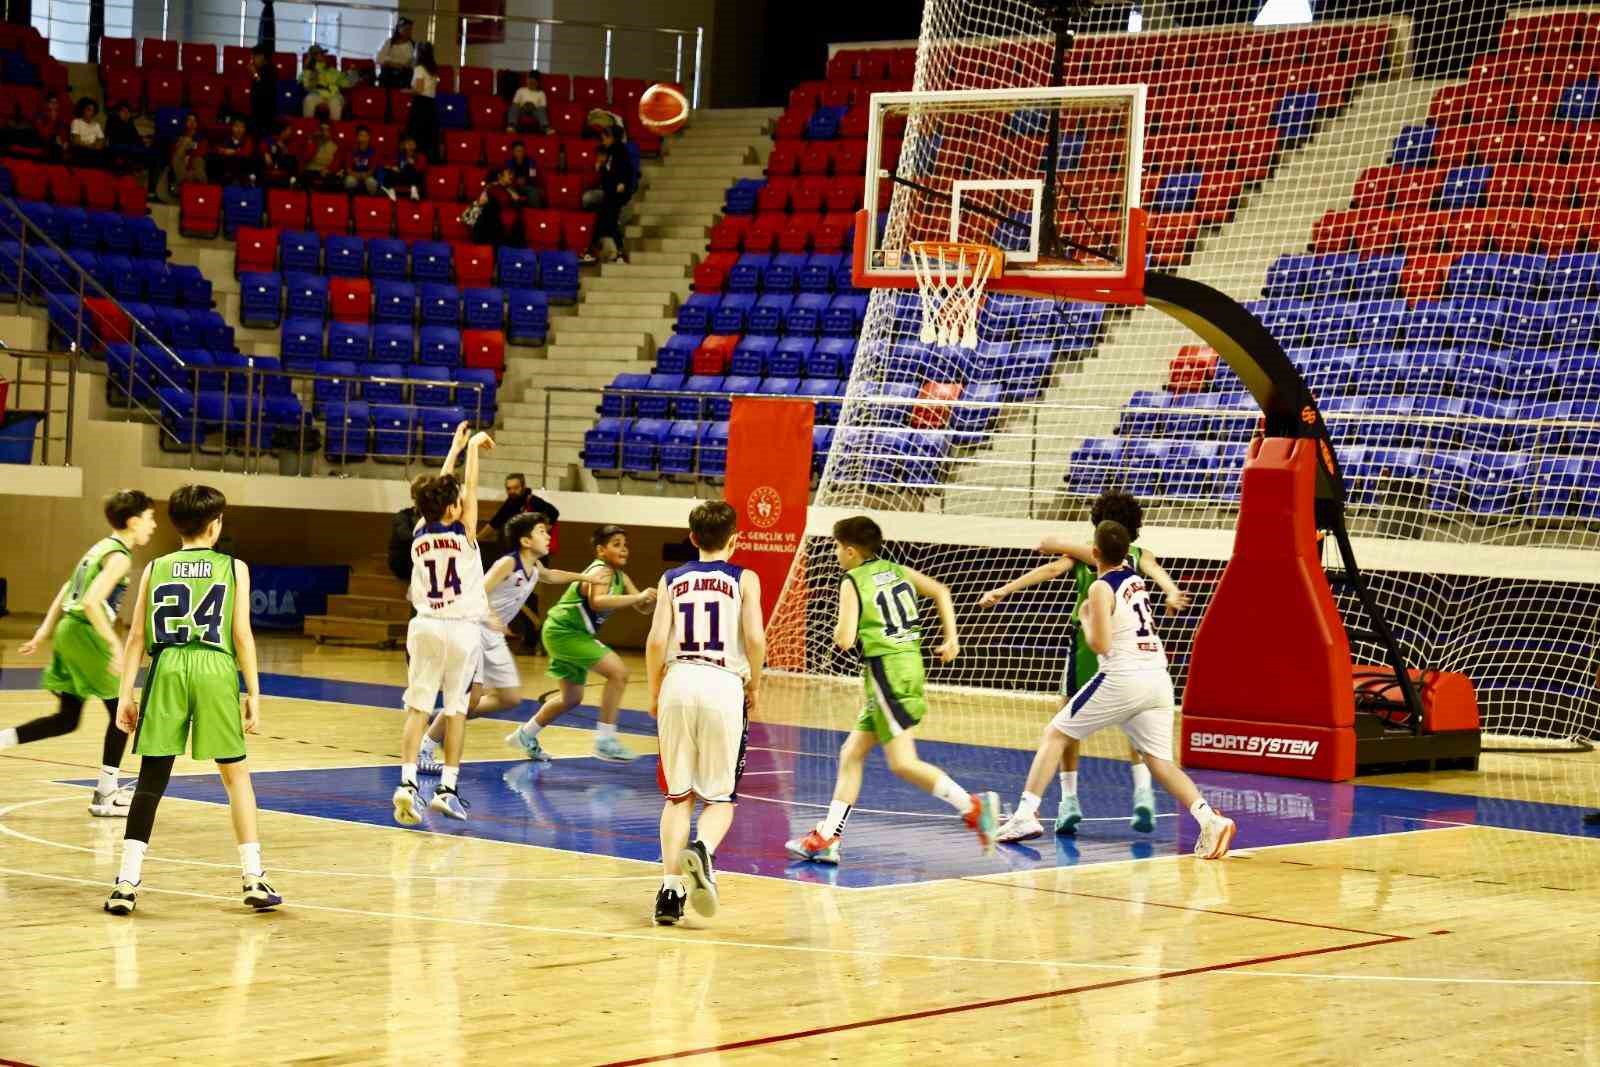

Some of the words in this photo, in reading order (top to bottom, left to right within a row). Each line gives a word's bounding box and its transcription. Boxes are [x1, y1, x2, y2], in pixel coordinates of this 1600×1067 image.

[415, 541, 431, 557] TED
[735, 542, 752, 550] POR
[748, 531, 783, 542] GENÇLİK
[785, 532, 797, 541] VE
[172, 558, 213, 578] DEMİR
[424, 556, 462, 599] 14
[693, 578, 735, 599] ANKARA
[152, 582, 228, 645] 24
[250, 589, 297, 615] OLA
[873, 581, 919, 637] 10
[679, 600, 725, 652] 11
[1190, 732, 1319, 758] SPORTSYSTEM
